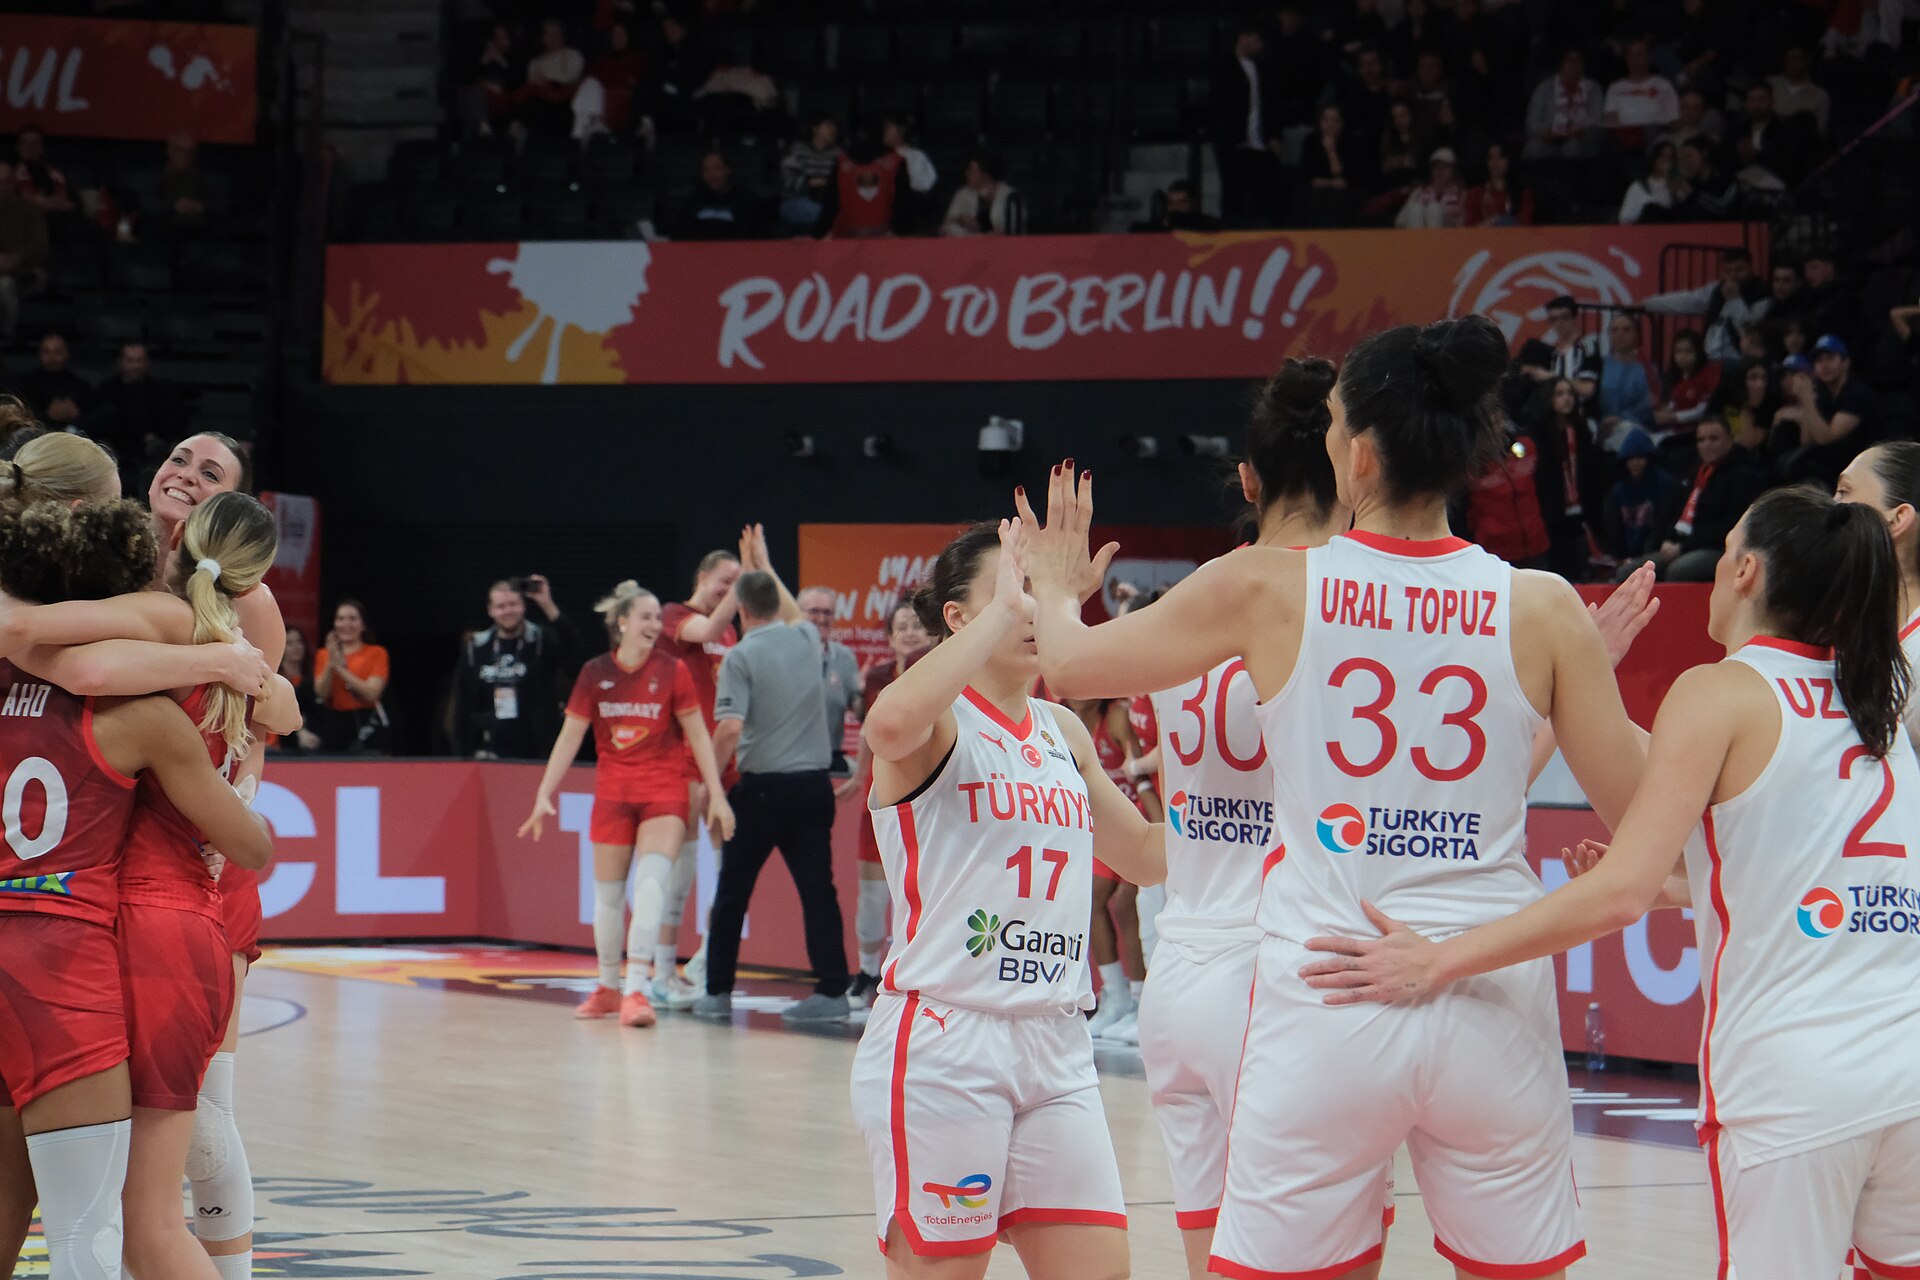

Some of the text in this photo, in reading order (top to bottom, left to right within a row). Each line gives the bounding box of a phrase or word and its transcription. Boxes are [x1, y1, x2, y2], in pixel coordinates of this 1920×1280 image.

[0, 46, 90, 112] UL
[717, 246, 1323, 369] ROAD TO BERLIN!!
[1320, 577, 1497, 636] URAL TOPUZ
[1169, 659, 1267, 772] 30
[1326, 657, 1488, 782] 33
[2, 756, 68, 861] 0
[1838, 744, 1907, 858] 2
[1005, 845, 1069, 901] 17
[924, 1212, 993, 1225] TotalEnergies
